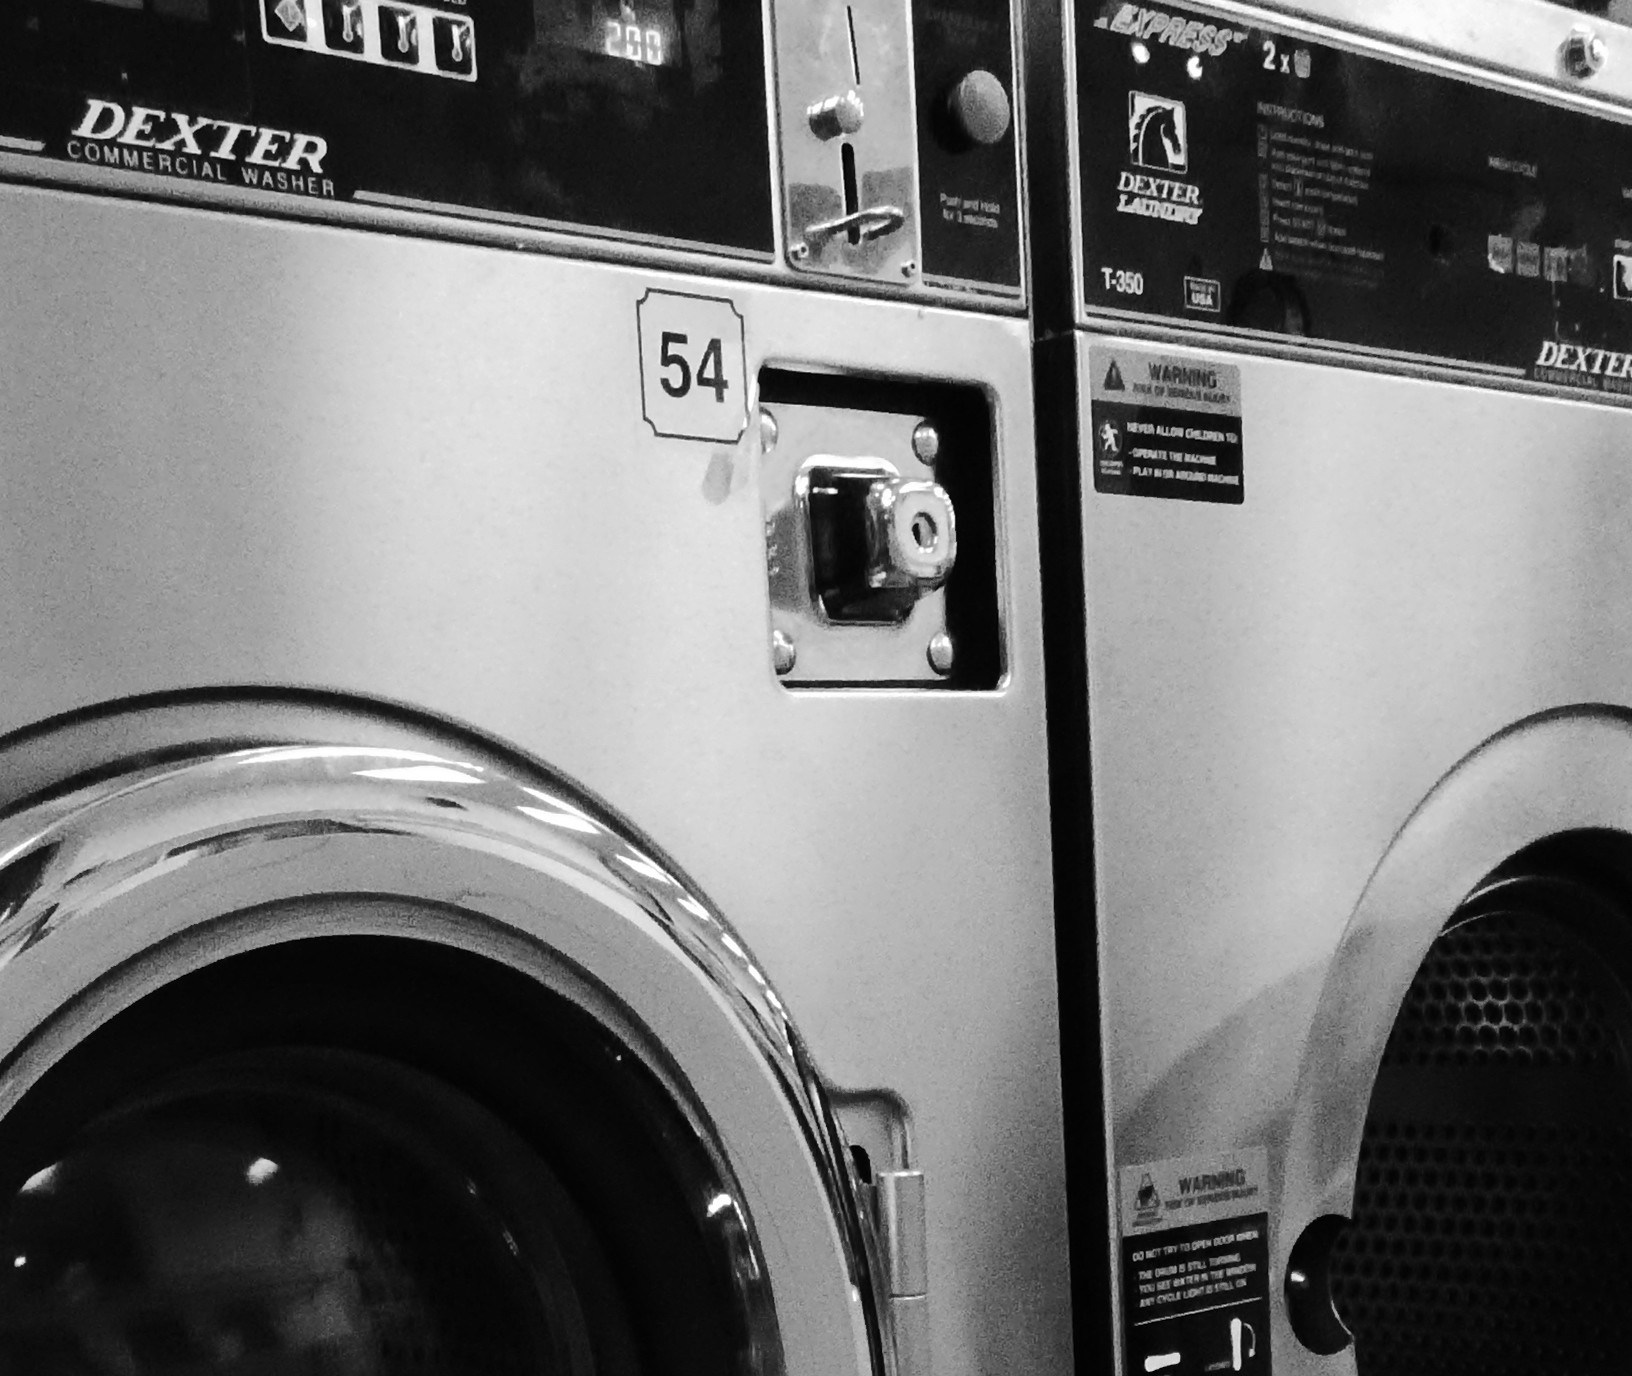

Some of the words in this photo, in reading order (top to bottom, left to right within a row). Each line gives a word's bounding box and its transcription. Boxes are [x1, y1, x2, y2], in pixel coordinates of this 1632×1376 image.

[71, 98, 328, 173] DEXTER
[67, 140, 228, 182] COMMERCIAL
[241, 166, 335, 198] WASHER
[1117, 171, 1200, 205] DEXTER
[1116, 194, 1203, 225] LAUNDRY
[1100, 267, 1144, 296] T-350
[659, 331, 729, 403] 54
